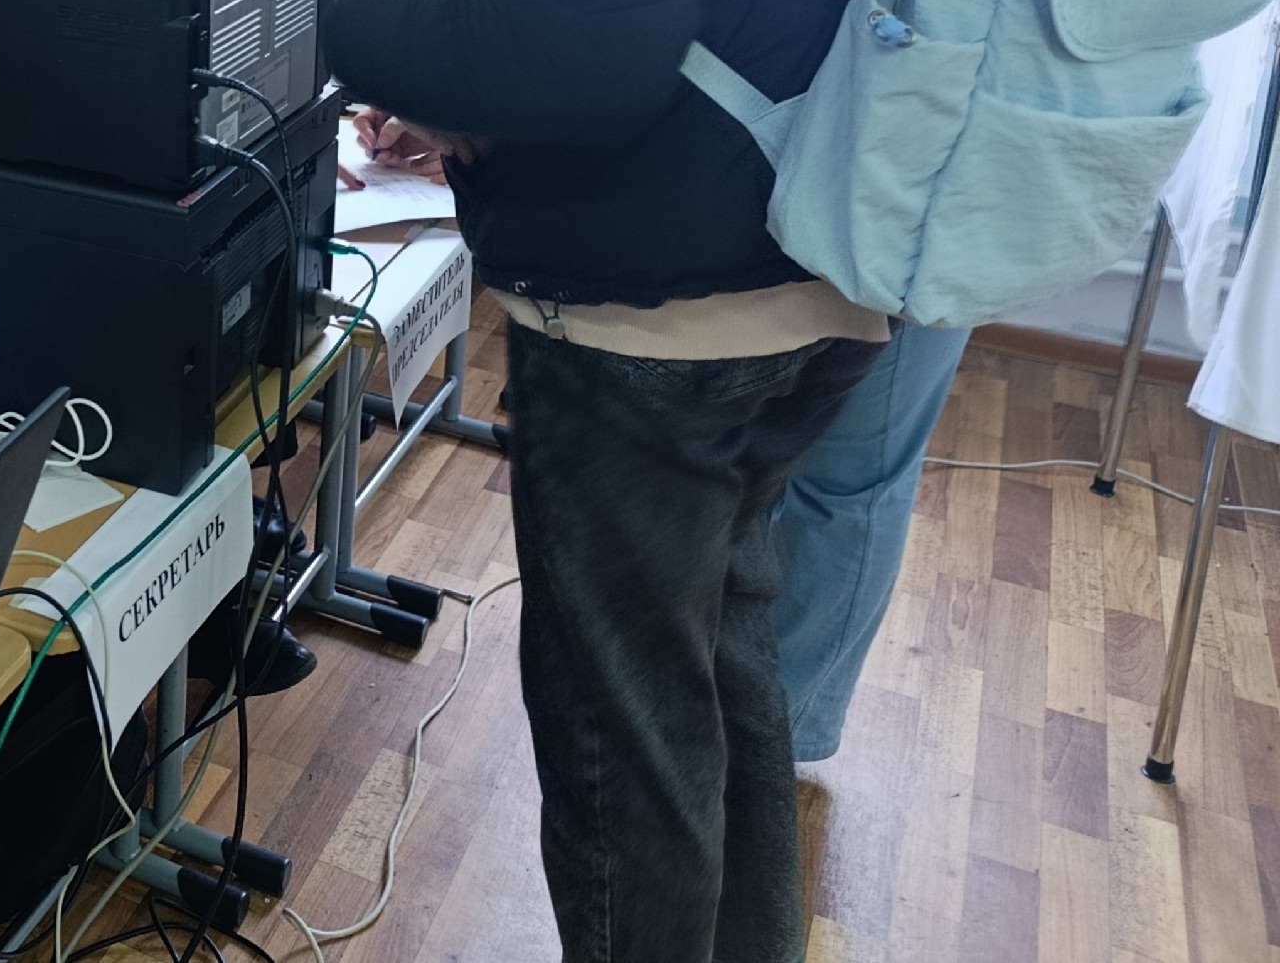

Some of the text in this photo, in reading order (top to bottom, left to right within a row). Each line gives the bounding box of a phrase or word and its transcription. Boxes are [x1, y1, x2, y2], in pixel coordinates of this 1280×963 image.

[391, 279, 464, 387] ПРЕДСЕДАТЕЛЯ
[393, 252, 465, 348] ЗАМЕСТИТЕЛЬ
[118, 513, 226, 643] СЕКРЕТАРЬ
